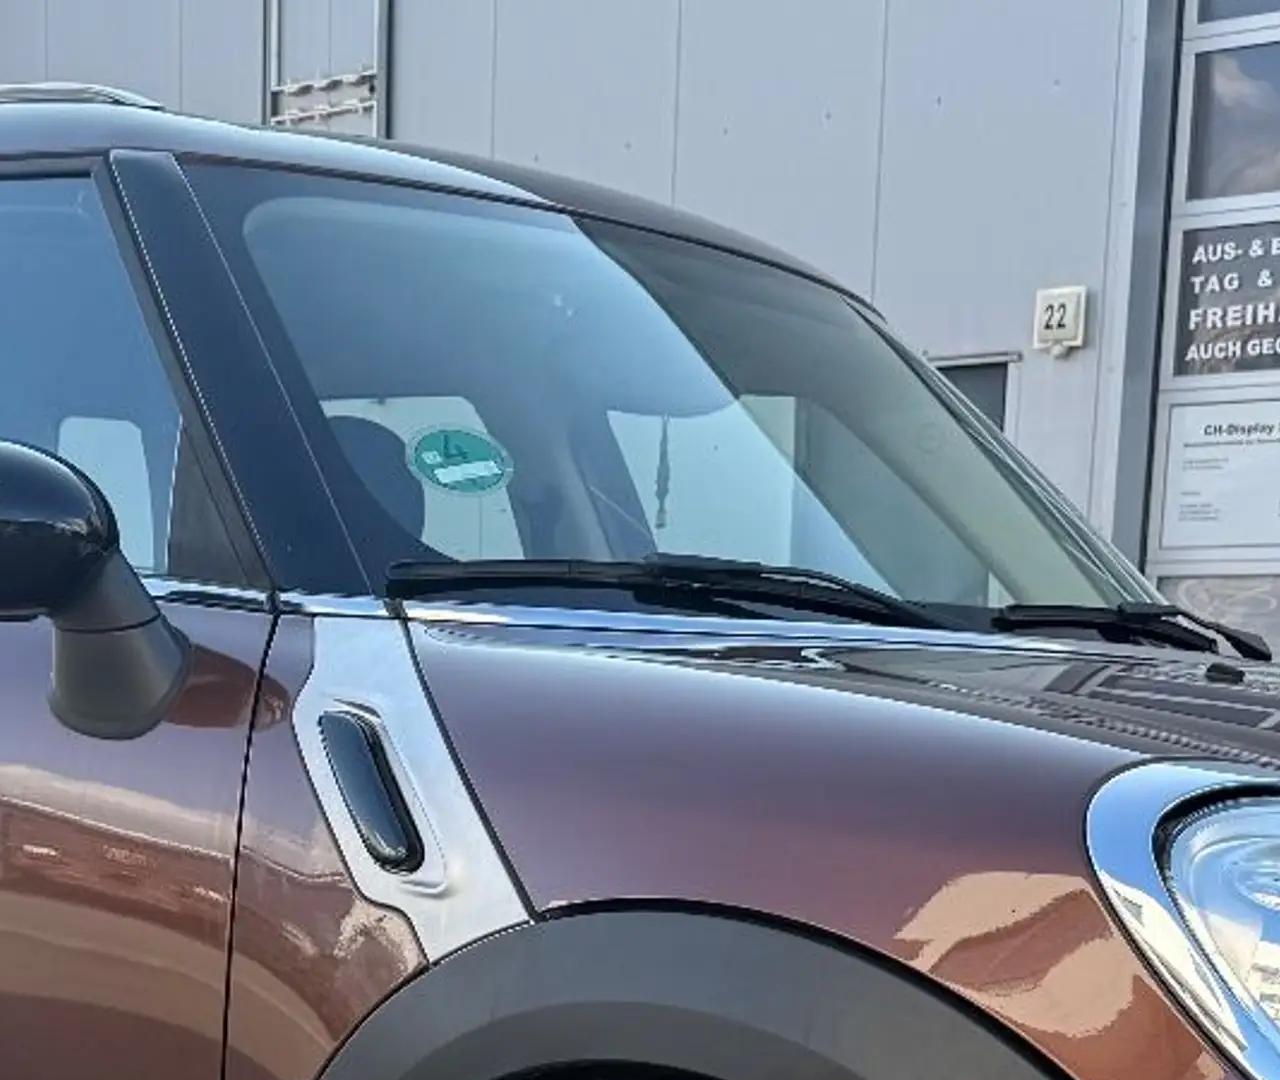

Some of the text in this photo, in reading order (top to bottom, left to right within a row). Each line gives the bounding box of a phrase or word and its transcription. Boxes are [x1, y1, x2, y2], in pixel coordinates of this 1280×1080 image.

[1192, 240, 1243, 264] AUS-
[1249, 239, 1264, 258] &
[1190, 272, 1239, 295] TAG
[1257, 268, 1273, 288] &
[1043, 303, 1067, 330] 22
[1185, 339, 1241, 361] AUCH
